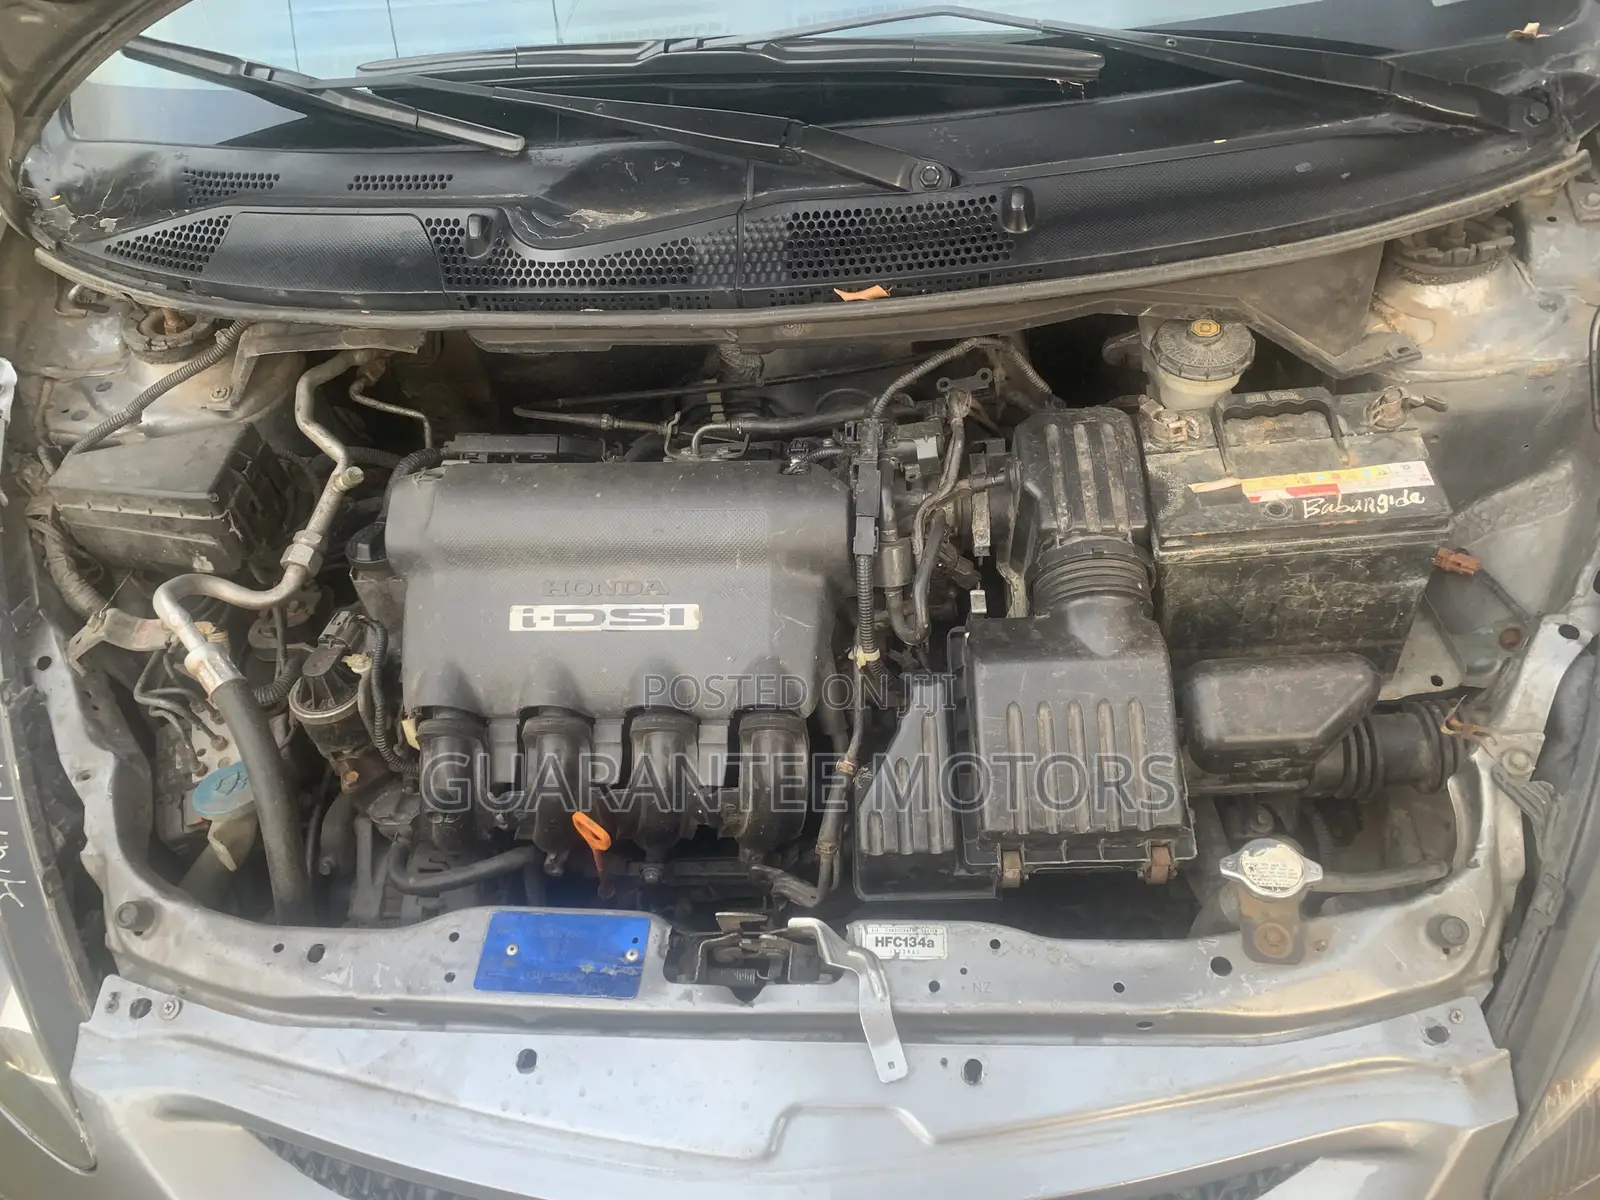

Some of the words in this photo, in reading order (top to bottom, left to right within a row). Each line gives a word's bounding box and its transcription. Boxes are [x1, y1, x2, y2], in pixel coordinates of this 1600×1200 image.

[542, 580, 670, 598] HONDA
[521, 607, 686, 629] i-DSI
[875, 936, 935, 949] HFC134a
[972, 981, 993, 994] NZ
